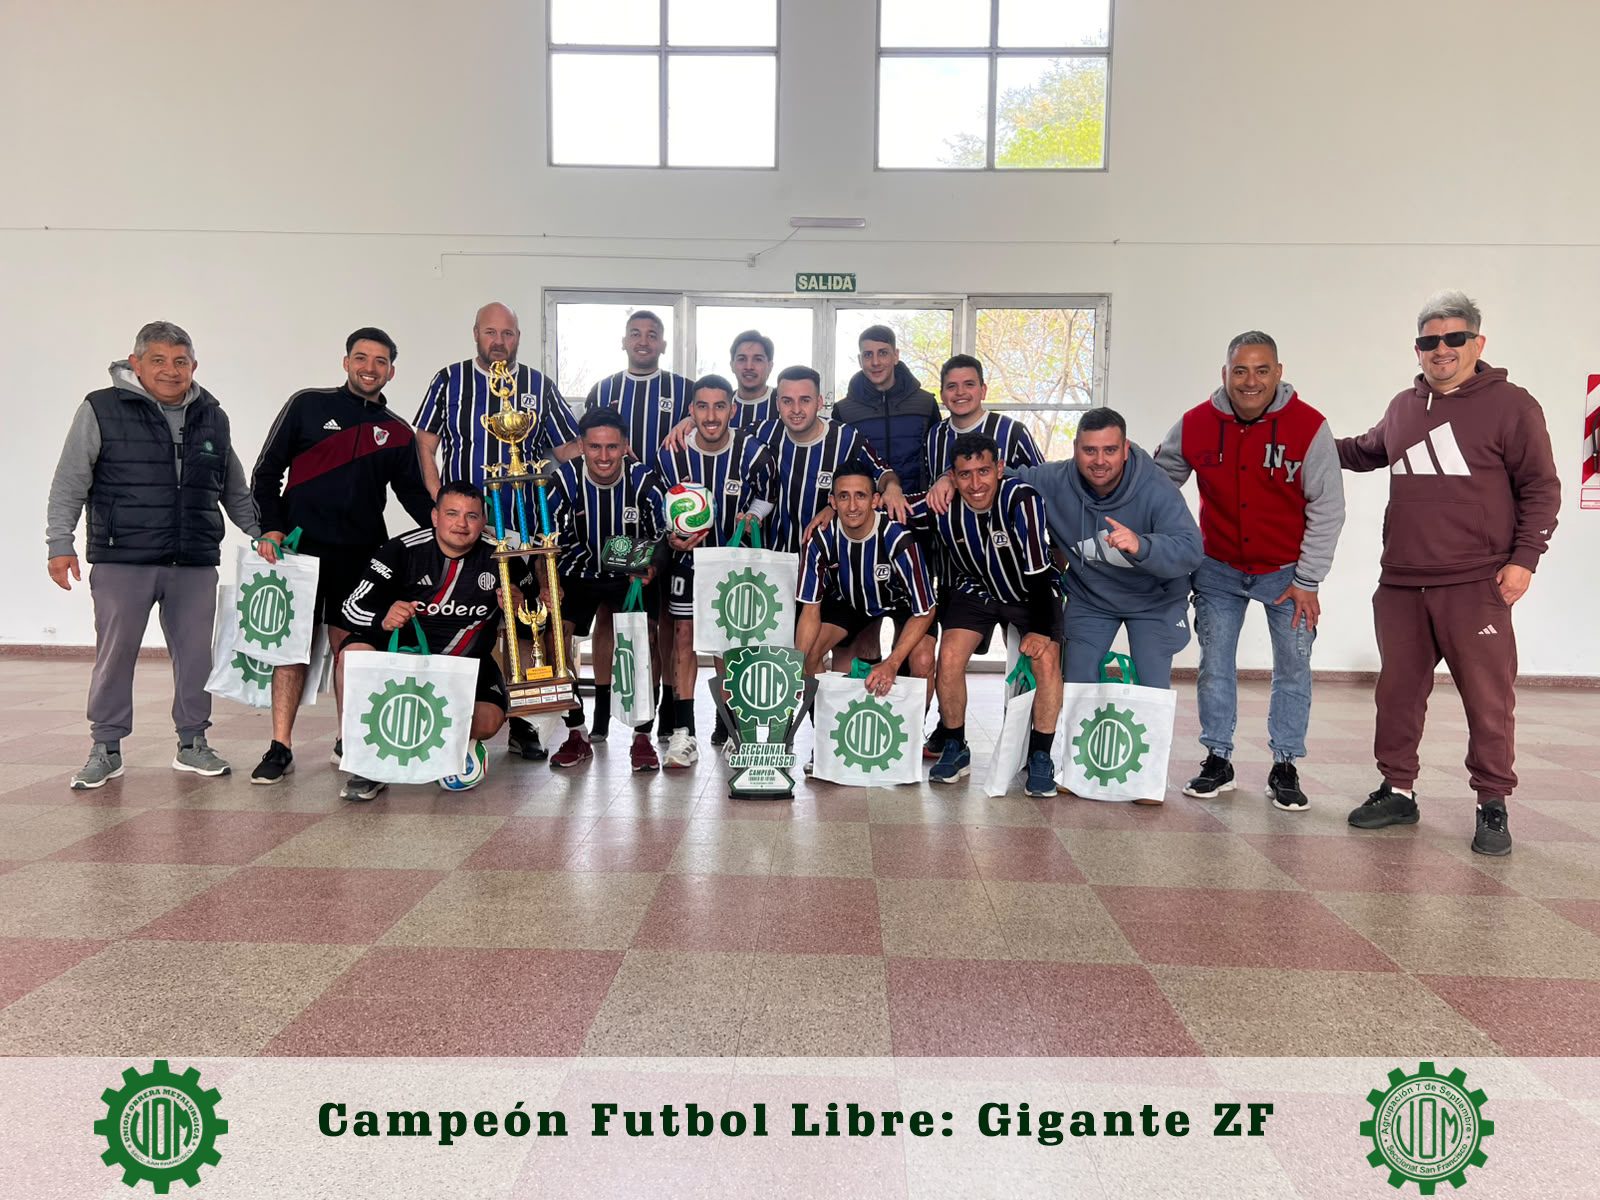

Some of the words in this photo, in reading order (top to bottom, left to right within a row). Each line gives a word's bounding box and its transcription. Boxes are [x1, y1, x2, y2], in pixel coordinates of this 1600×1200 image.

[798, 275, 853, 290] SALIDA
[415, 600, 488, 616] codere
[740, 744, 785, 755] SECCIONAL
[749, 756, 795, 766] FRANCISCO
